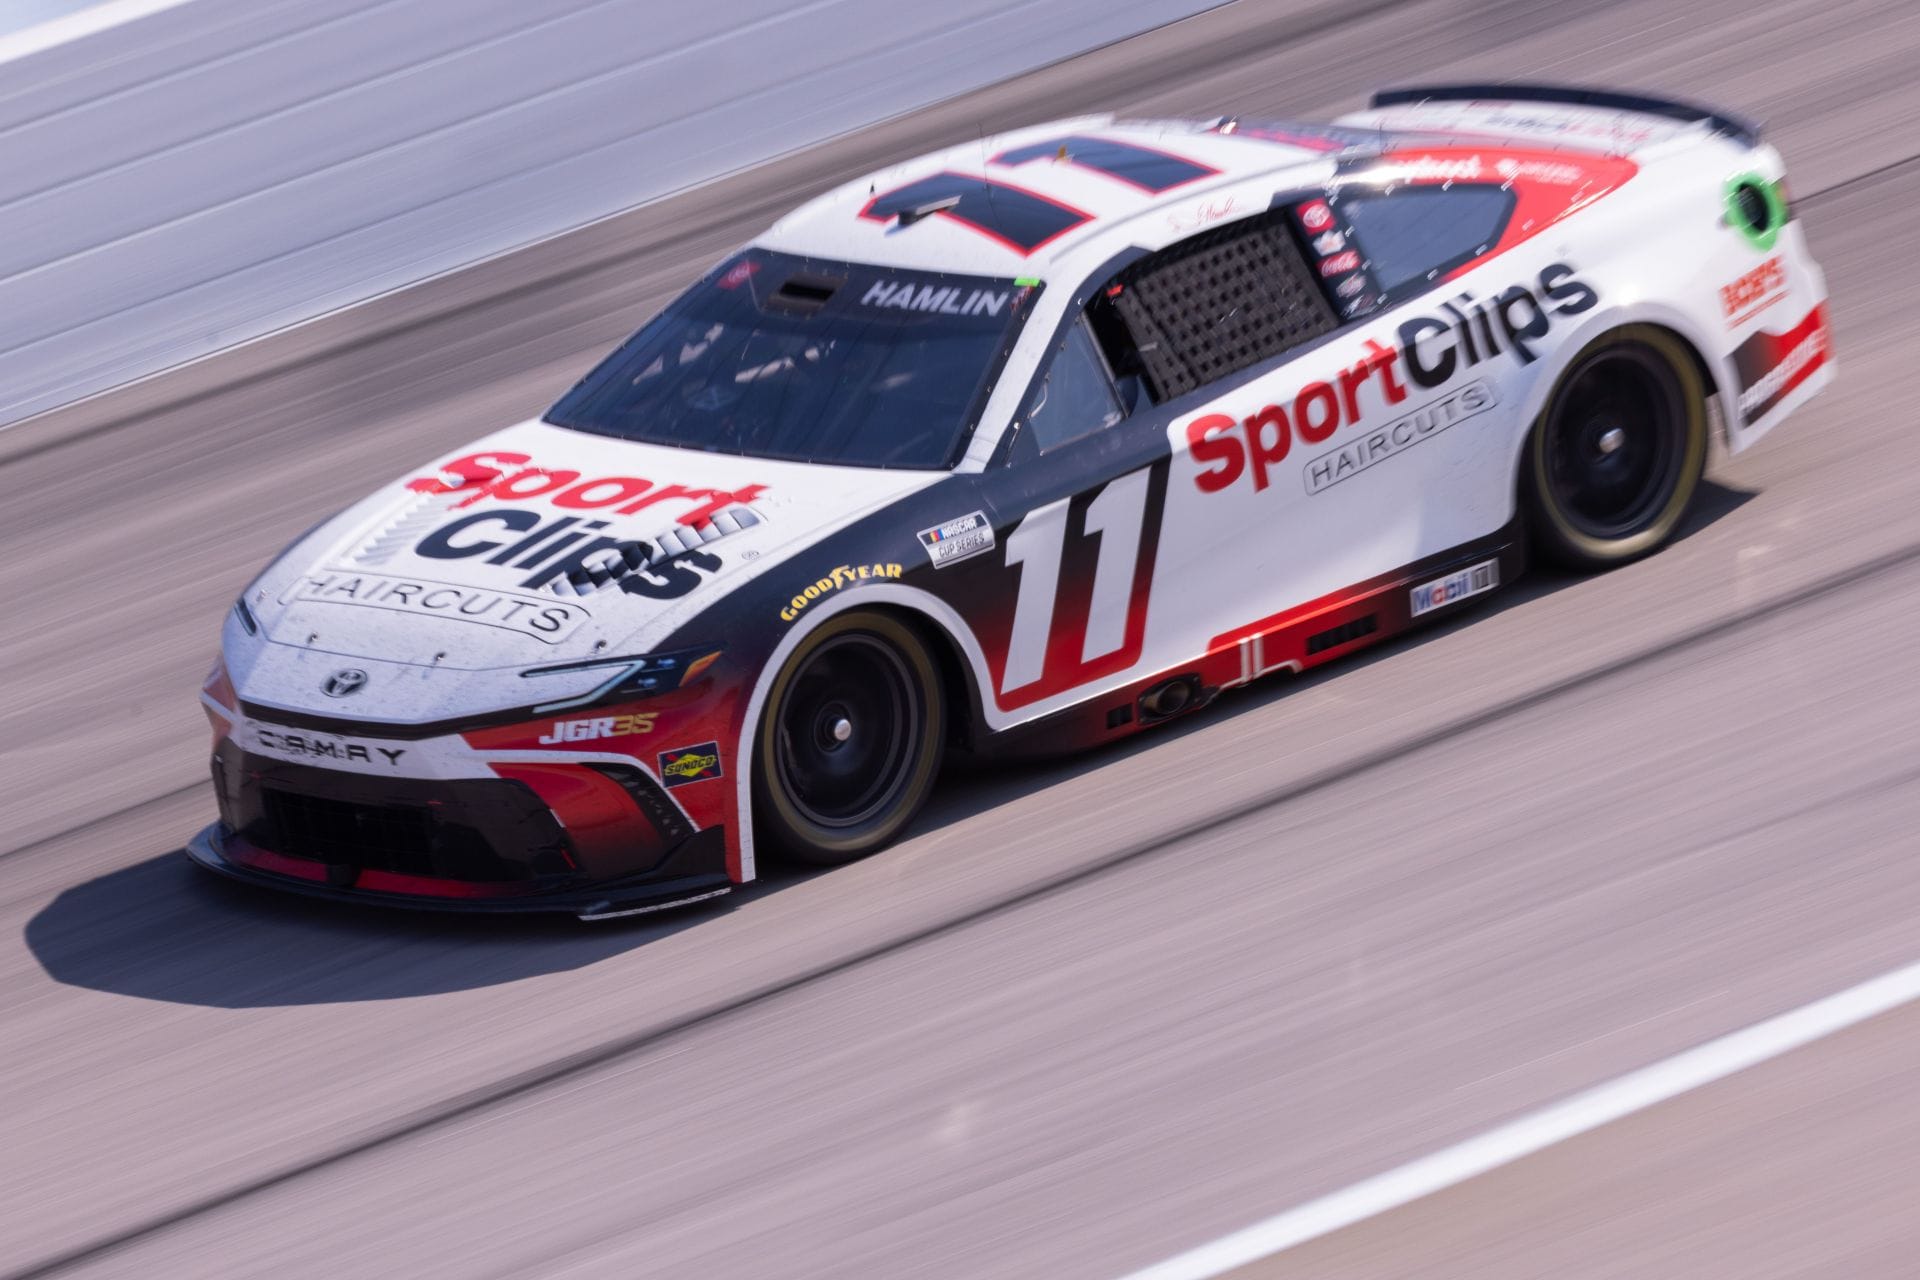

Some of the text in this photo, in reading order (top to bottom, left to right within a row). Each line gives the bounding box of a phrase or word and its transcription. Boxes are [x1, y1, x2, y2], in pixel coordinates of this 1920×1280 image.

[860, 280, 1010, 317] HAMLIN
[1311, 384, 1490, 488] HAIRCUTS
[403, 450, 771, 531] Sport
[414, 509, 723, 600] Clips
[939, 532, 985, 559] CUP SERIES
[942, 516, 978, 540] NASCAR
[309, 575, 573, 633] HAIRCUTS
[780, 563, 903, 621] GOODYEAR
[1001, 465, 1152, 694] 11
[257, 729, 407, 766] CAMRY
[663, 753, 717, 776] SONOCO
